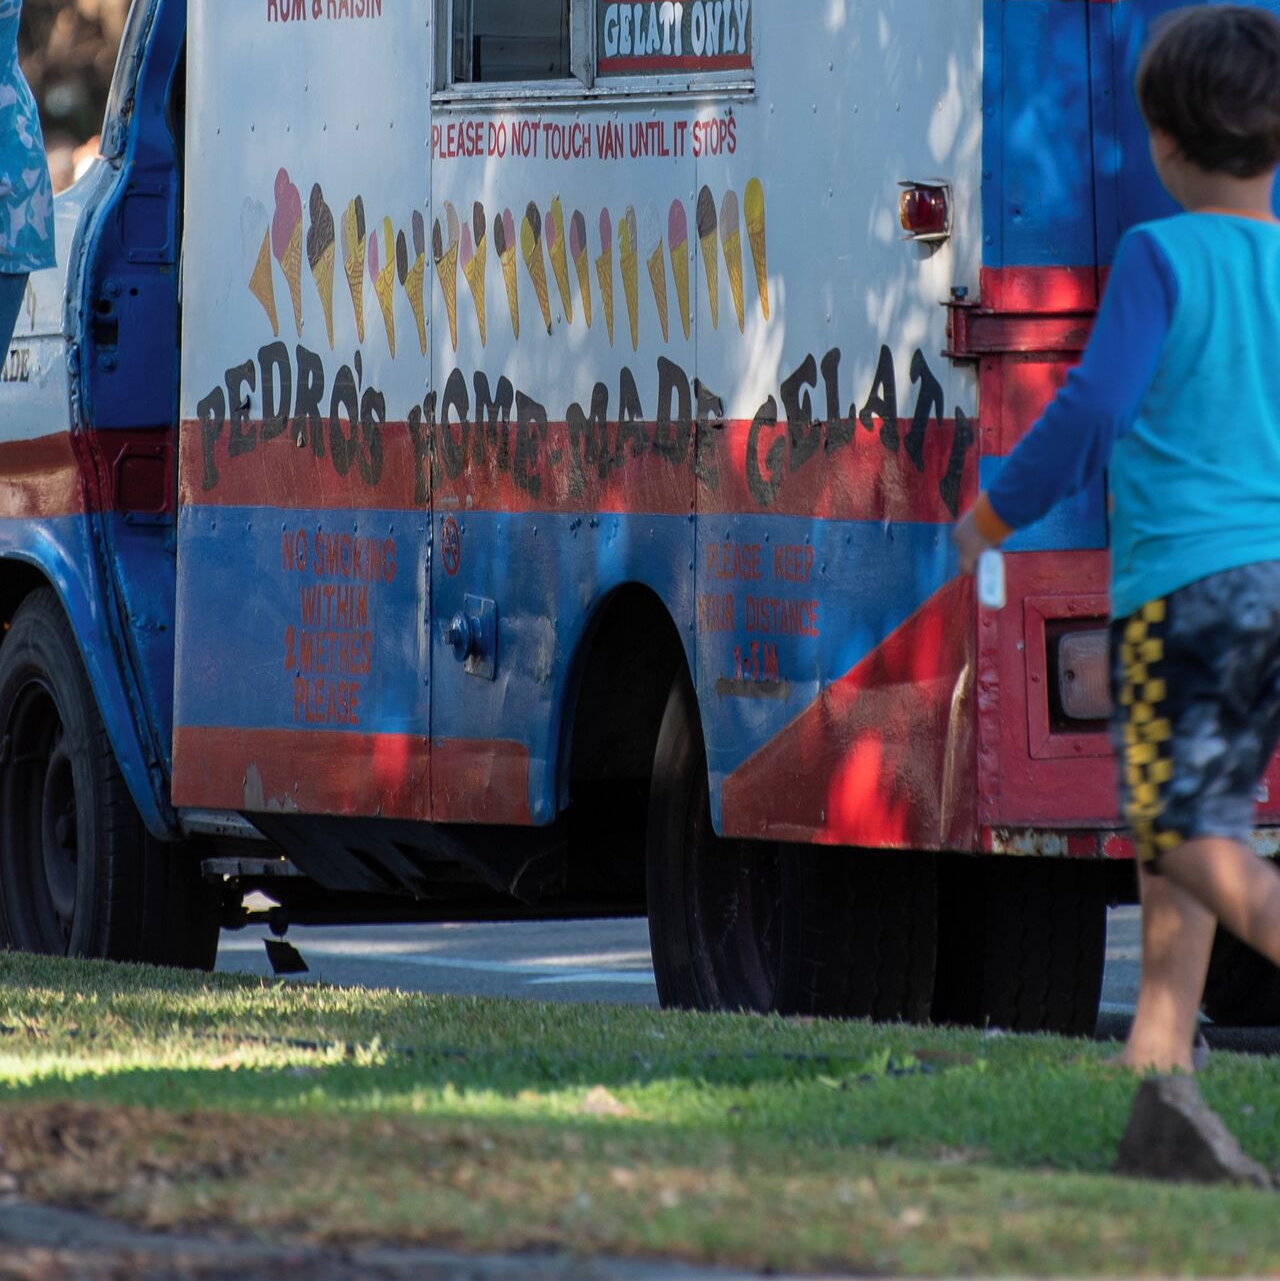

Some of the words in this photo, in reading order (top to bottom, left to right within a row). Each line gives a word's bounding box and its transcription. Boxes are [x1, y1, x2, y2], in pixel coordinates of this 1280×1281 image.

[604, 0, 683, 58] GELATI
[432, 121, 484, 159] PLEASE
[488, 121, 507, 158] DO
[512, 120, 541, 158] NOT
[543, 121, 591, 160] TOUCH
[596, 120, 624, 160] VAN
[629, 120, 669, 158] UNTIL
[674, 121, 687, 158] IT
[692, 116, 736, 158] STOPS
[196, 341, 385, 492] PEDRO'S
[746, 344, 974, 518] GELATI
[281, 527, 307, 573] NO
[313, 531, 396, 584] SMOKING
[706, 542, 762, 581] PLEASE
[774, 544, 815, 583] KEEP
[301, 584, 368, 628] WITHIN
[745, 595, 819, 639] DISTANCE
[284, 625, 296, 670] 2
[299, 630, 373, 675] METRES
[294, 678, 359, 725] PLEASE
